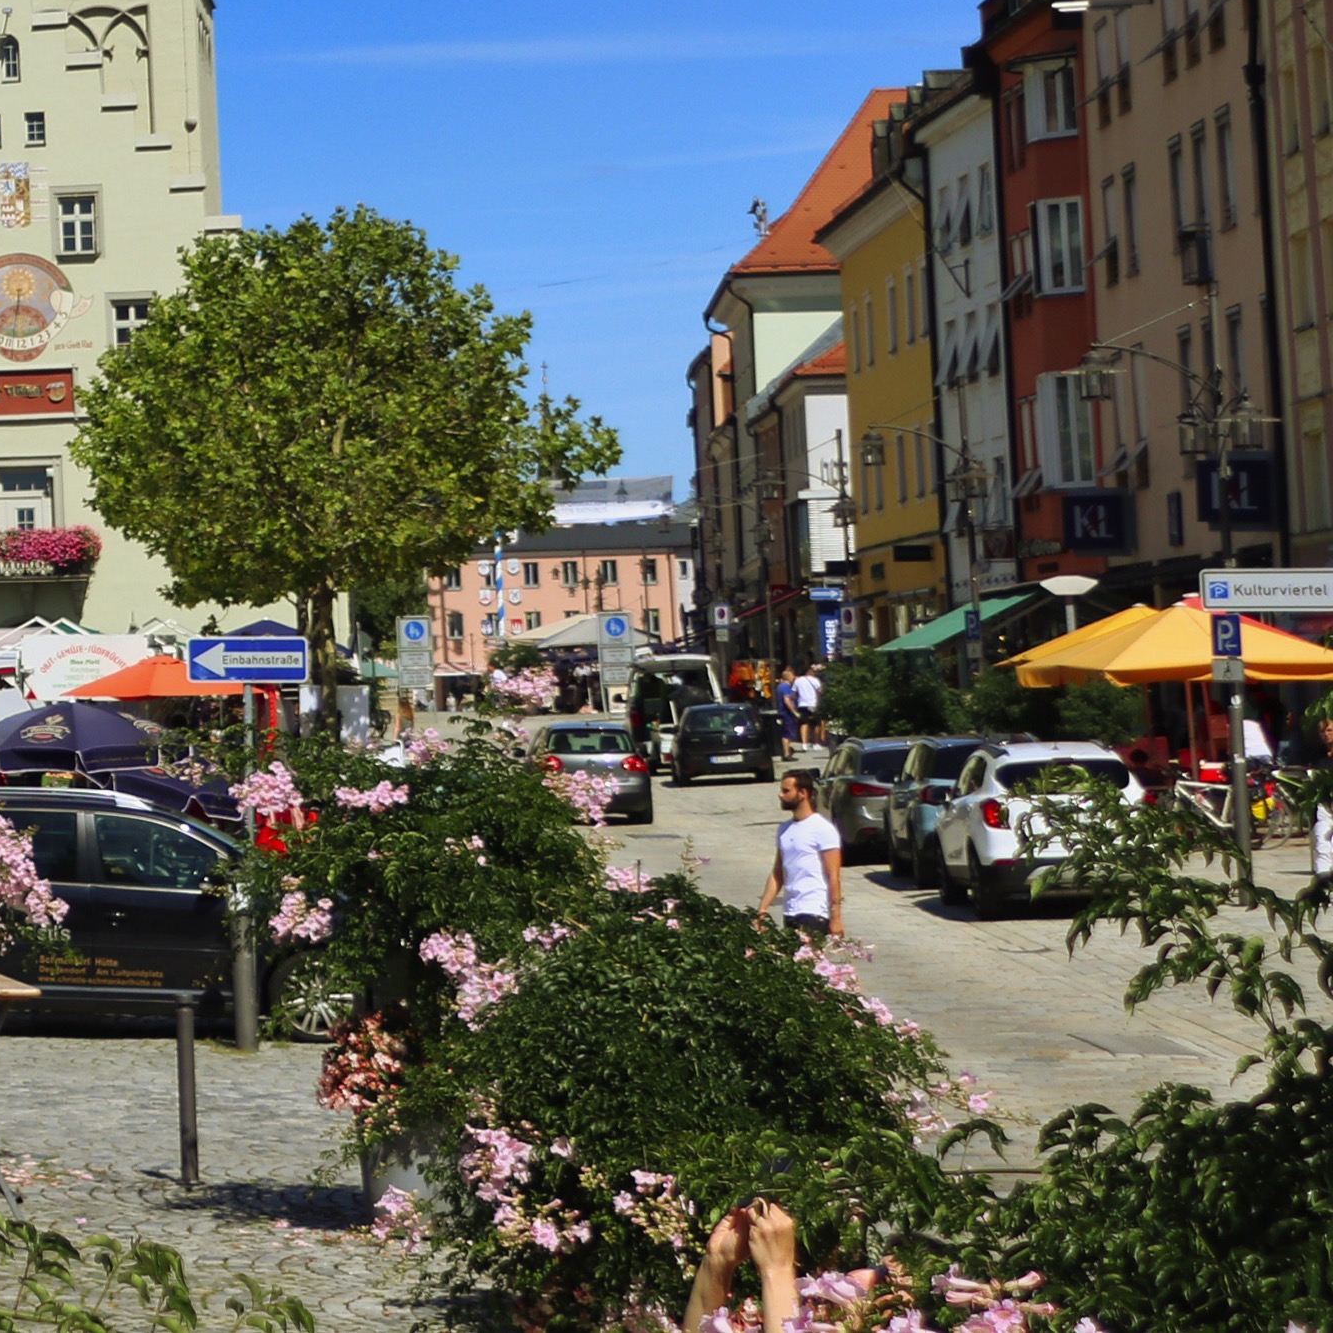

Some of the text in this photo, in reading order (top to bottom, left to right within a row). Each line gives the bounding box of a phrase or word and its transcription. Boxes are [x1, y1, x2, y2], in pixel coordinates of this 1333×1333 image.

[53, 321, 61, 330] 4
[38, 334, 45, 343] 2
[45, 330, 52, 339] 3
[16, 338, 27, 349] 12
[1234, 584, 1328, 596] Kulturviertel
[87, 644, 128, 668] SÜDFRÜCHT
[222, 655, 300, 665] Einbahnstraße
[94, 957, 119, 967] Hütte
[96, 968, 109, 976] Am
[111, 969, 164, 979] Luitpoldplatz
